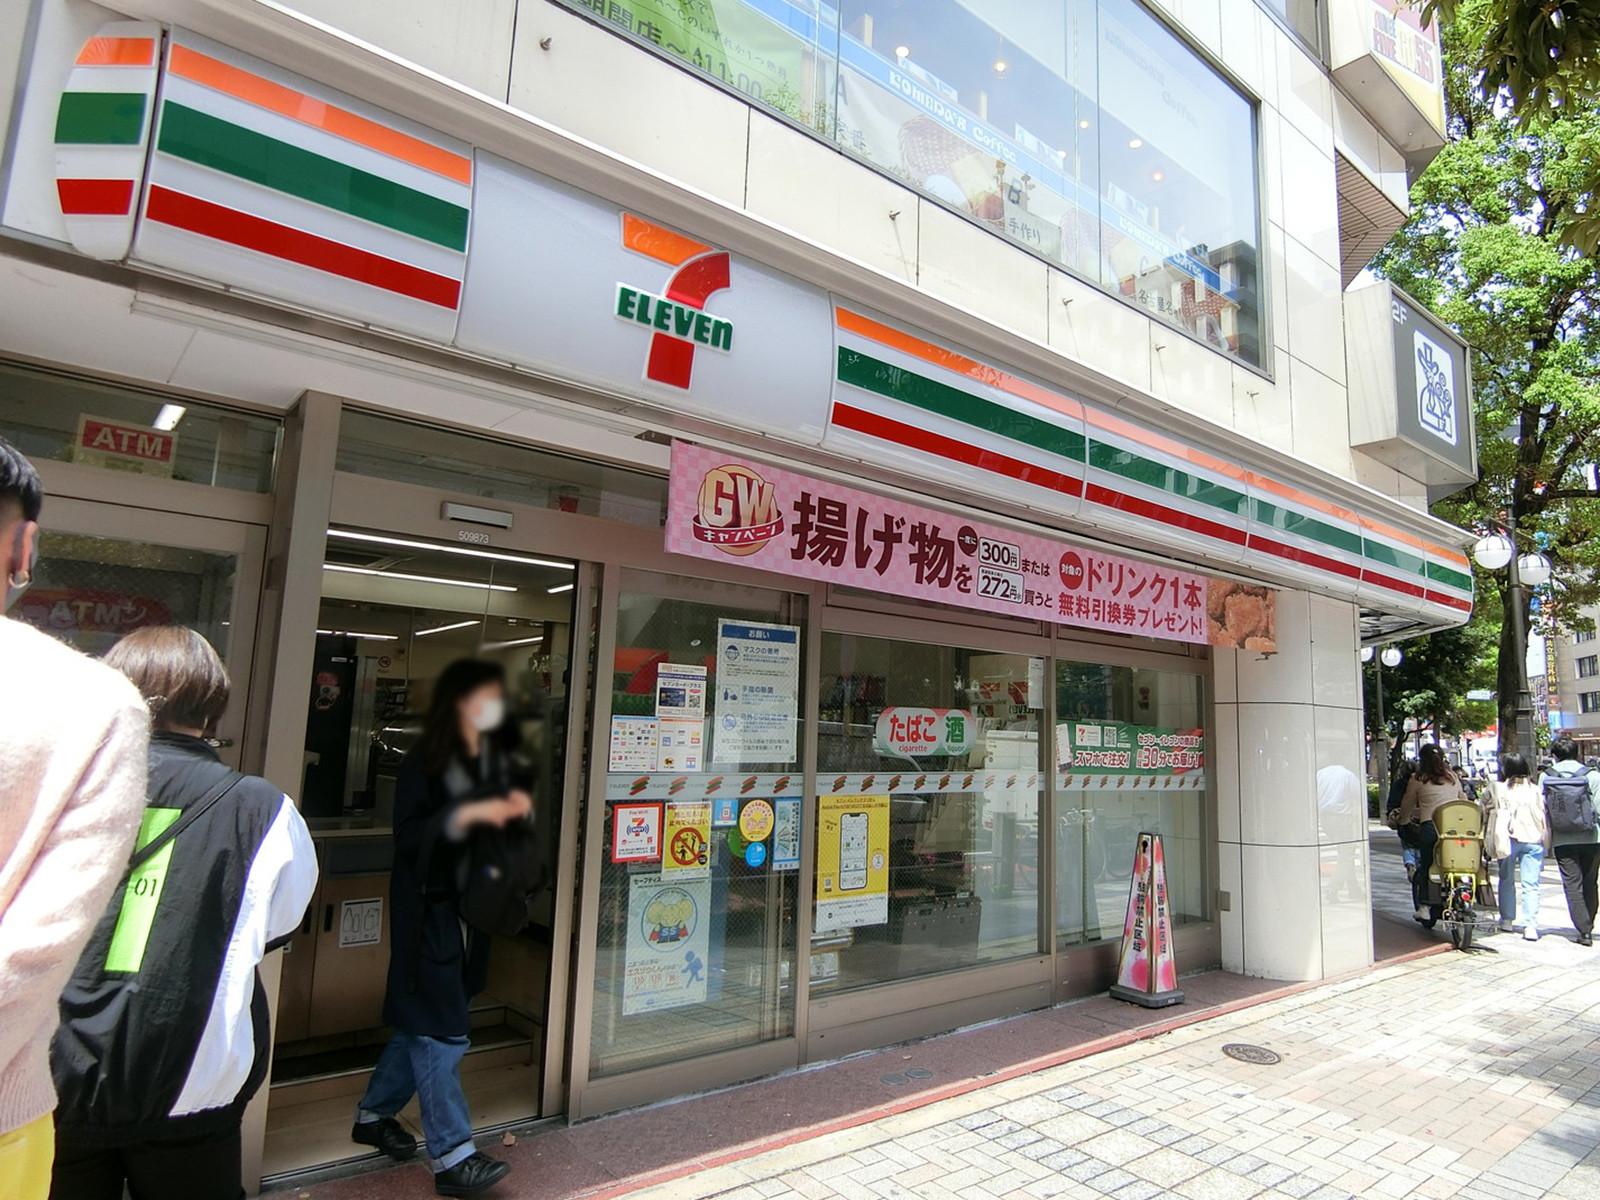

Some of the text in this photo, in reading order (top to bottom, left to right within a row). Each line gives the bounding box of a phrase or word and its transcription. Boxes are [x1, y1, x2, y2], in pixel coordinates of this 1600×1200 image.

[972, 126, 1017, 163] Coffee
[1007, 178, 1023, 205] B
[1008, 217, 1041, 245] 手作り
[1392, 300, 1407, 325] 2F
[92, 426, 164, 458] ATM
[702, 468, 775, 529] GW
[458, 530, 489, 543] 509873
[703, 524, 776, 542] キャンペーン
[981, 541, 1018, 568] 300円
[1021, 558, 1051, 577] または
[1087, 556, 1202, 612] ドリンク1本
[1023, 589, 1053, 608] 買うと
[748, 629, 770, 639] お願い
[890, 714, 965, 743] たばこ 酒
[661, 927, 678, 936] SS
